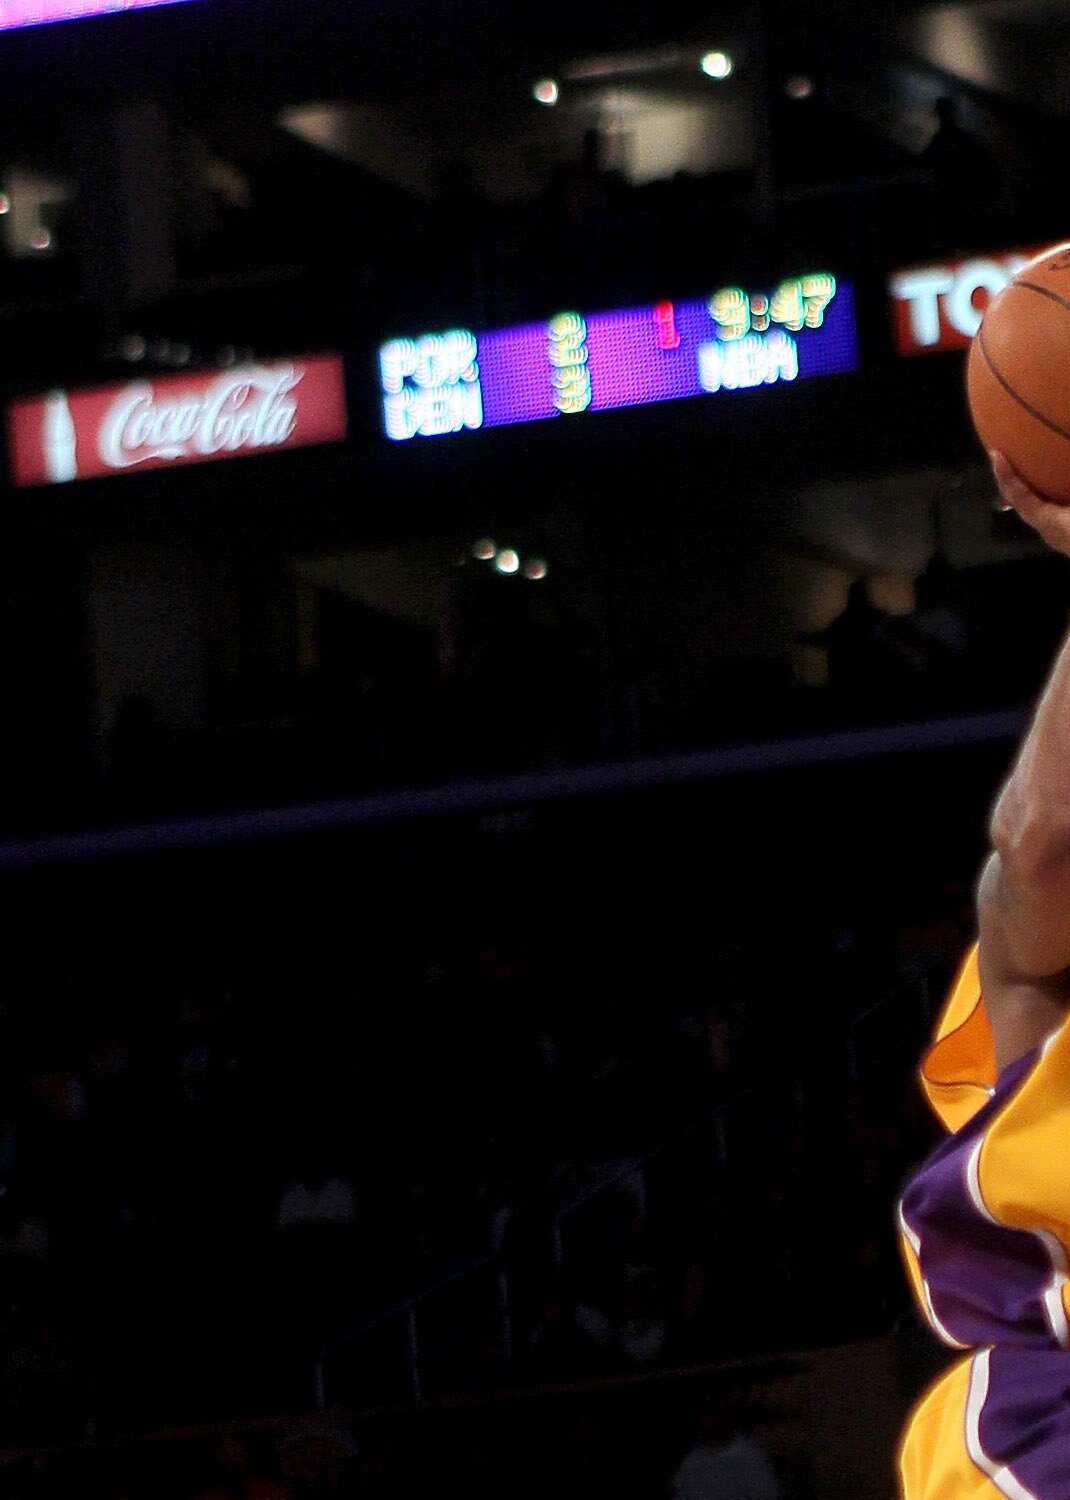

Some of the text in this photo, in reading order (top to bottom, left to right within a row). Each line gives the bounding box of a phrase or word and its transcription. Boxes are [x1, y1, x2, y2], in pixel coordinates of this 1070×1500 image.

[379, 327, 478, 393] POR
[654, 299, 680, 349] 1
[708, 271, 836, 341] 9:47
[384, 377, 483, 440] DEN
[697, 328, 799, 392] NBA
